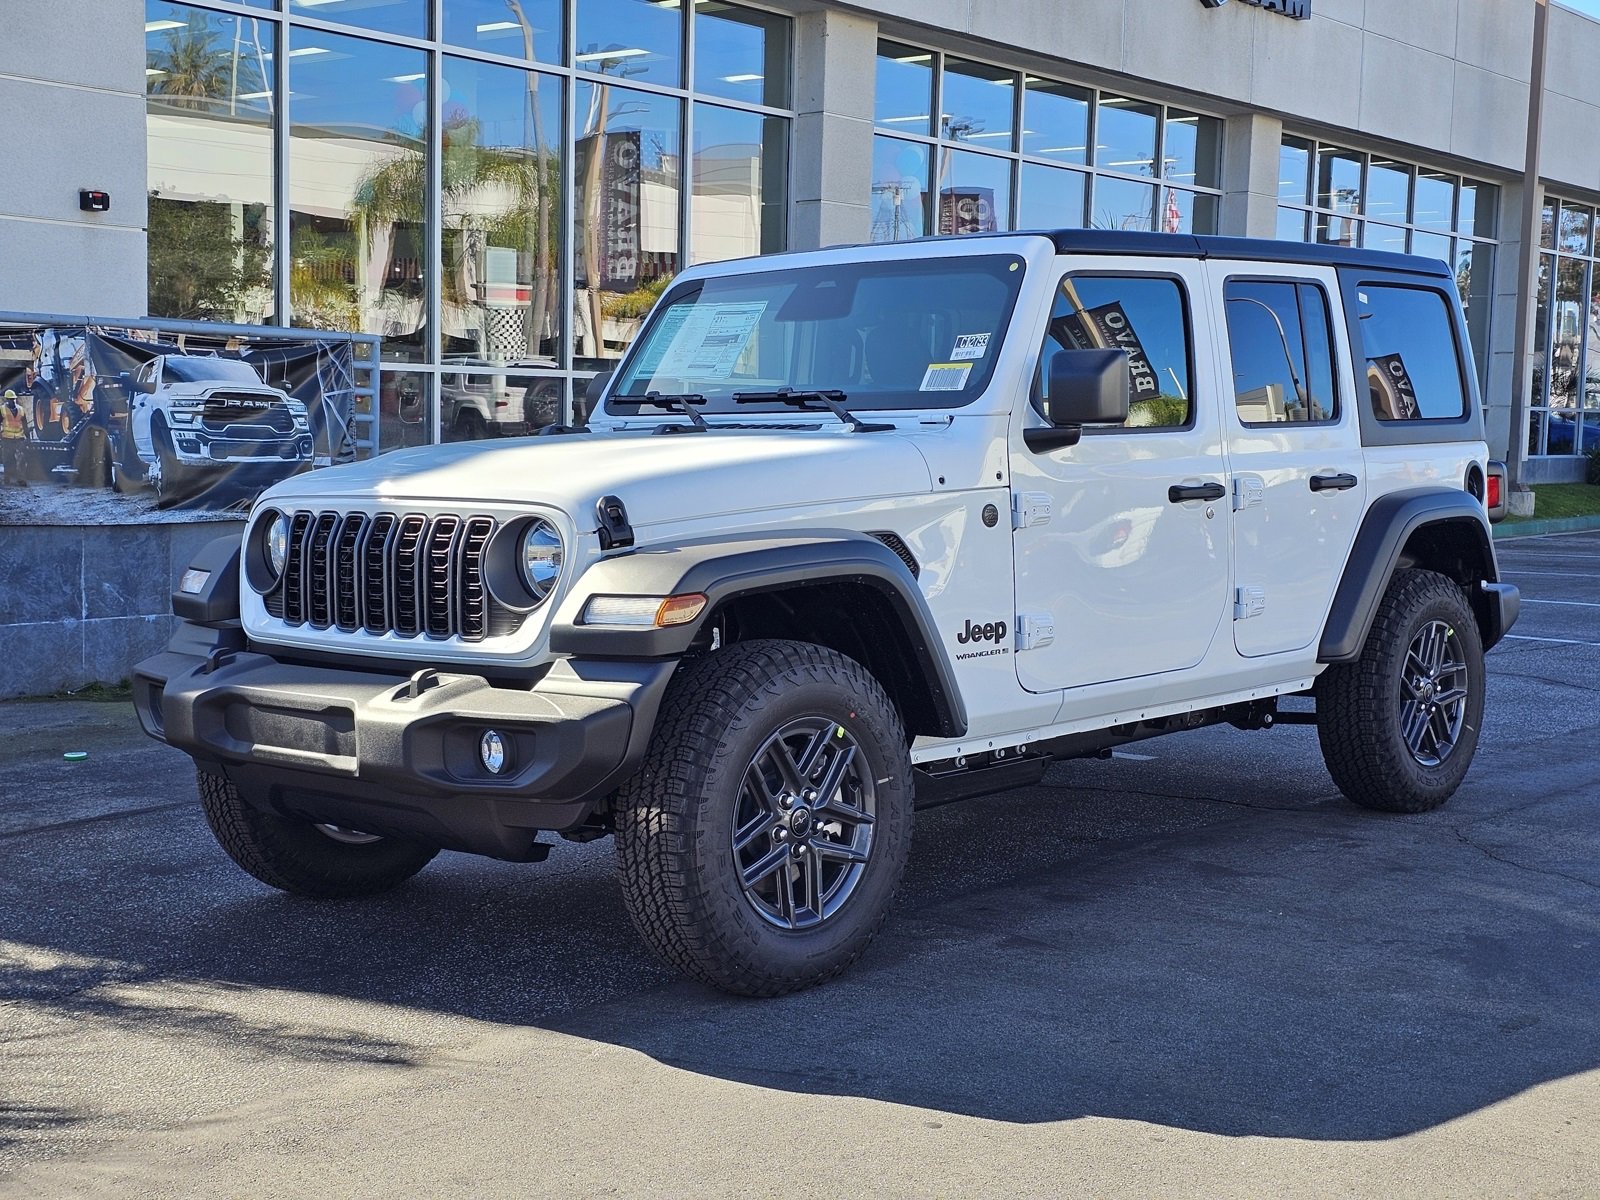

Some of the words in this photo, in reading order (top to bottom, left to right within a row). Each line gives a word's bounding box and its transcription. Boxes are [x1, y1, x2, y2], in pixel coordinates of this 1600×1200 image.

[228, 400, 268, 408] RAM
[957, 619, 1007, 645] Jeep
[955, 648, 1001, 661] WRANGLER
